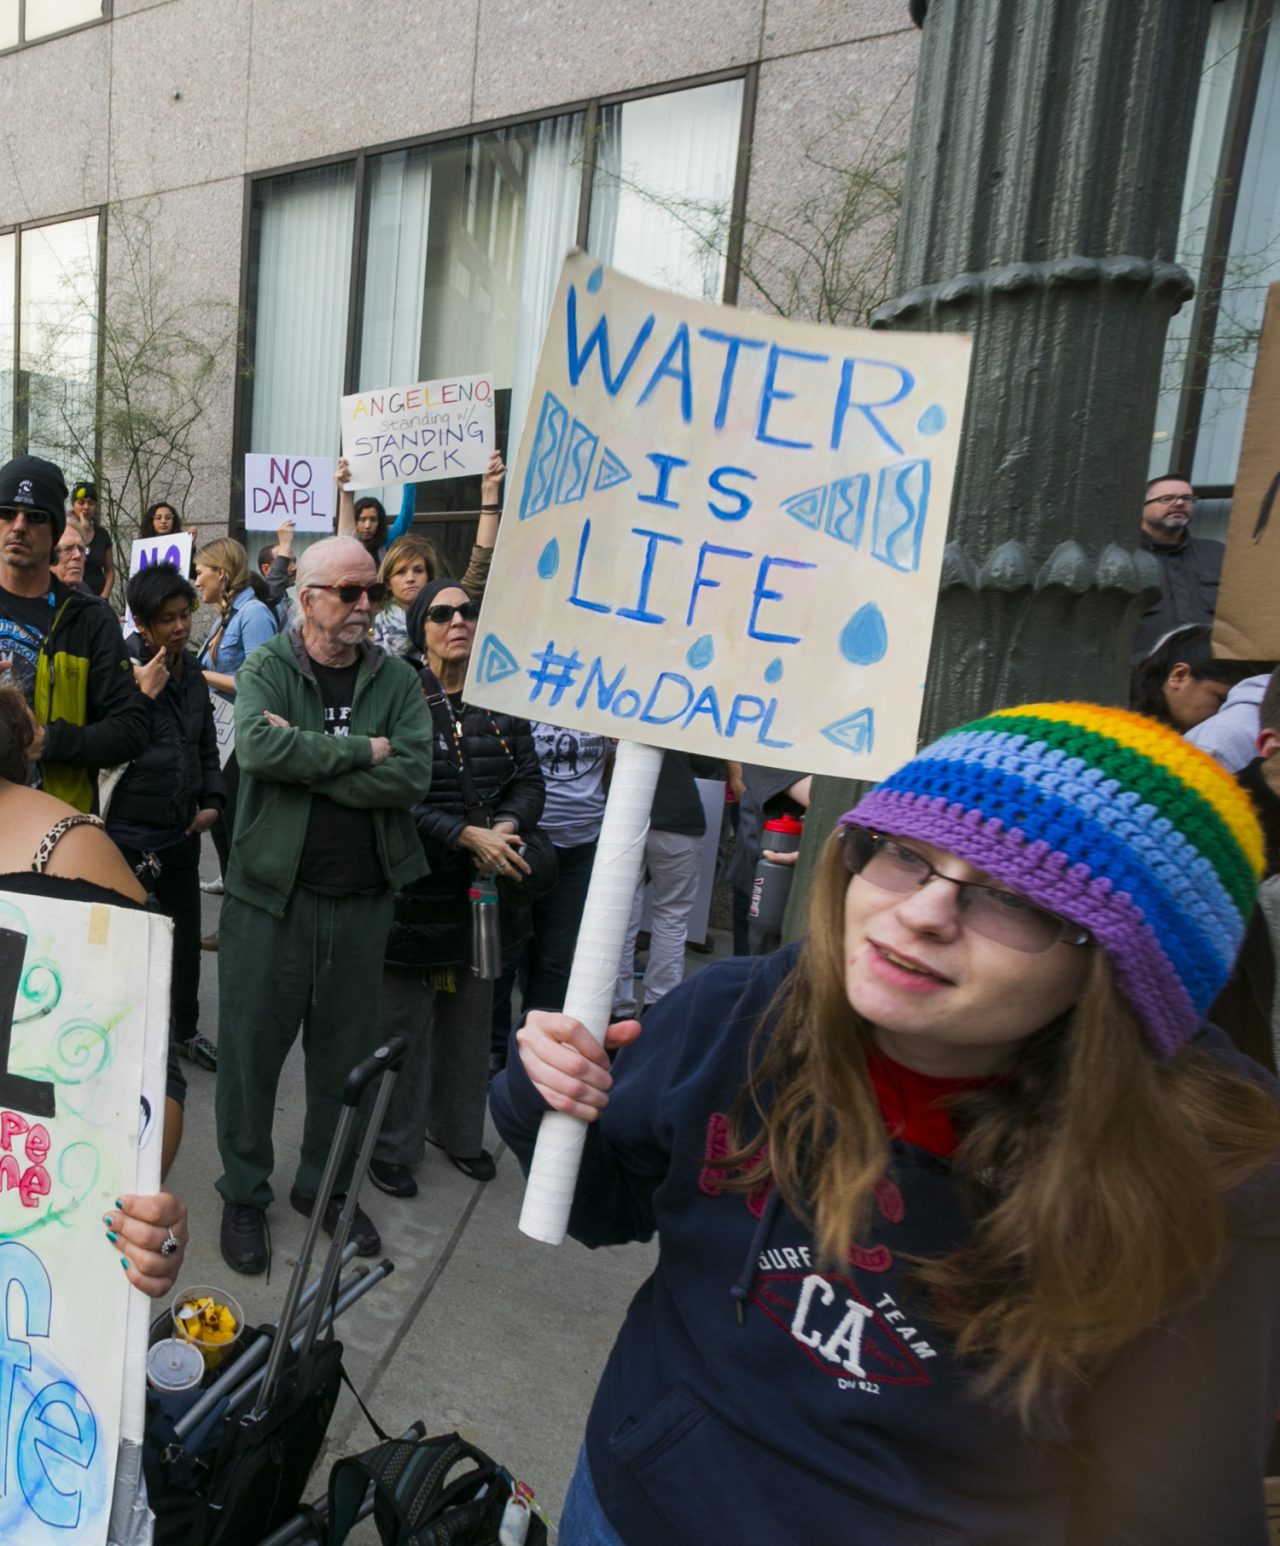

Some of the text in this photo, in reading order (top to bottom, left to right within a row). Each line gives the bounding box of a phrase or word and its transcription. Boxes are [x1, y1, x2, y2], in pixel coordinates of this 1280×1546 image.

[566, 283, 916, 456] WATER
[354, 421, 485, 457] STANDING
[270, 457, 313, 489] NO
[379, 449, 466, 481] ROCK
[637, 453, 758, 522] IS
[252, 486, 326, 517] DAPL
[567, 518, 818, 644] LIFE
[758, 1247, 812, 1270] SURF
[791, 1274, 874, 1379] CA
[875, 1292, 938, 1359] TEAM
